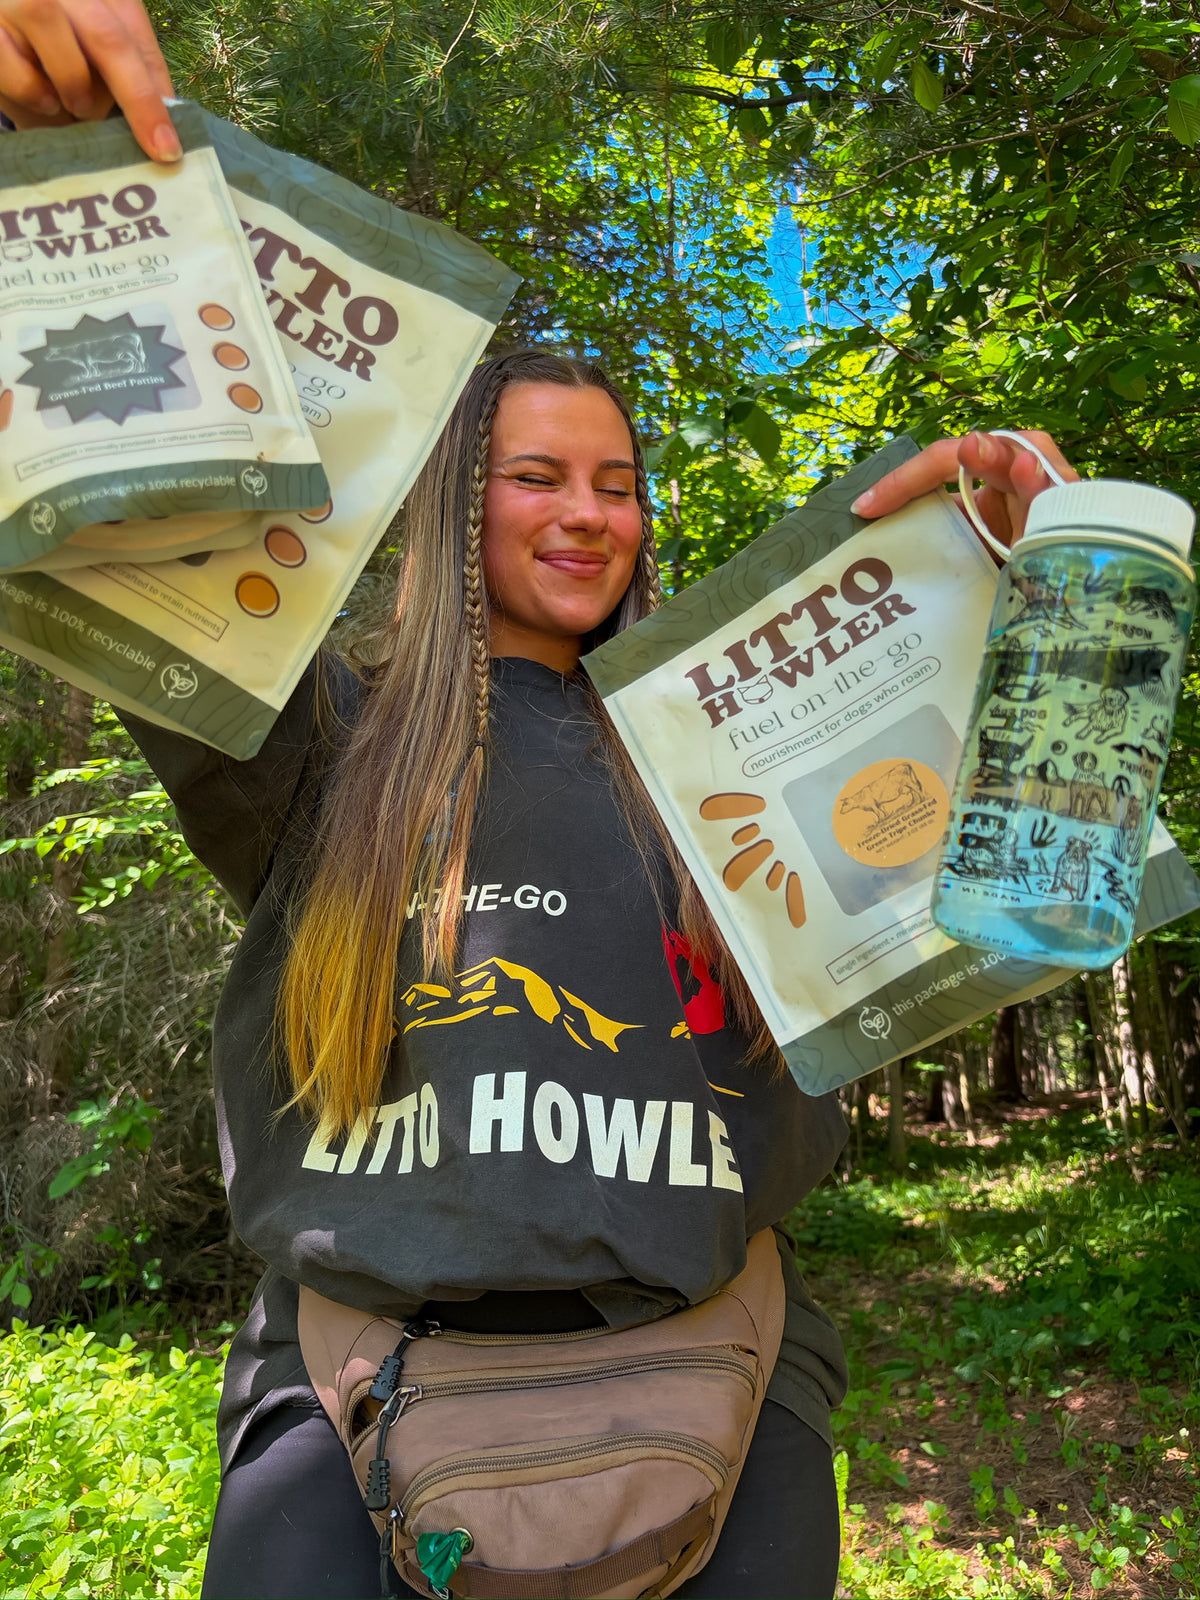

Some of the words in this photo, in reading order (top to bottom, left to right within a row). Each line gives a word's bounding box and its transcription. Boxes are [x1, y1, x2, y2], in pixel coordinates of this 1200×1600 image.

[0, 184, 157, 242] ITTO
[240, 219, 399, 346] TTO
[301, 400, 322, 420] am
[57, 496, 80, 512] this
[82, 484, 133, 504] package
[135, 480, 146, 492] is
[148, 479, 177, 491] 100%
[179, 474, 237, 493] recyclable
[34, 595, 48, 613] is
[50, 605, 86, 633] 100%
[87, 626, 157, 672] recyclable
[118, 566, 149, 592] crafted
[159, 591, 185, 611] retain
[185, 605, 221, 634] nutrients
[684, 557, 894, 702] LITTO
[728, 710, 785, 752] fuel
[750, 729, 825, 773] nourishment
[825, 718, 842, 735] for
[844, 700, 874, 725] dogs
[872, 682, 900, 705] who
[900, 663, 933, 688] roam
[835, 959, 857, 976] single
[856, 938, 891, 963] ingredient
[892, 999, 915, 1016] this
[914, 969, 967, 1007] package
[966, 962, 980, 977] is
[980, 950, 1011, 970] 100
[301, 1082, 440, 1175] LITTO
[469, 1071, 744, 1194] HOWLE
